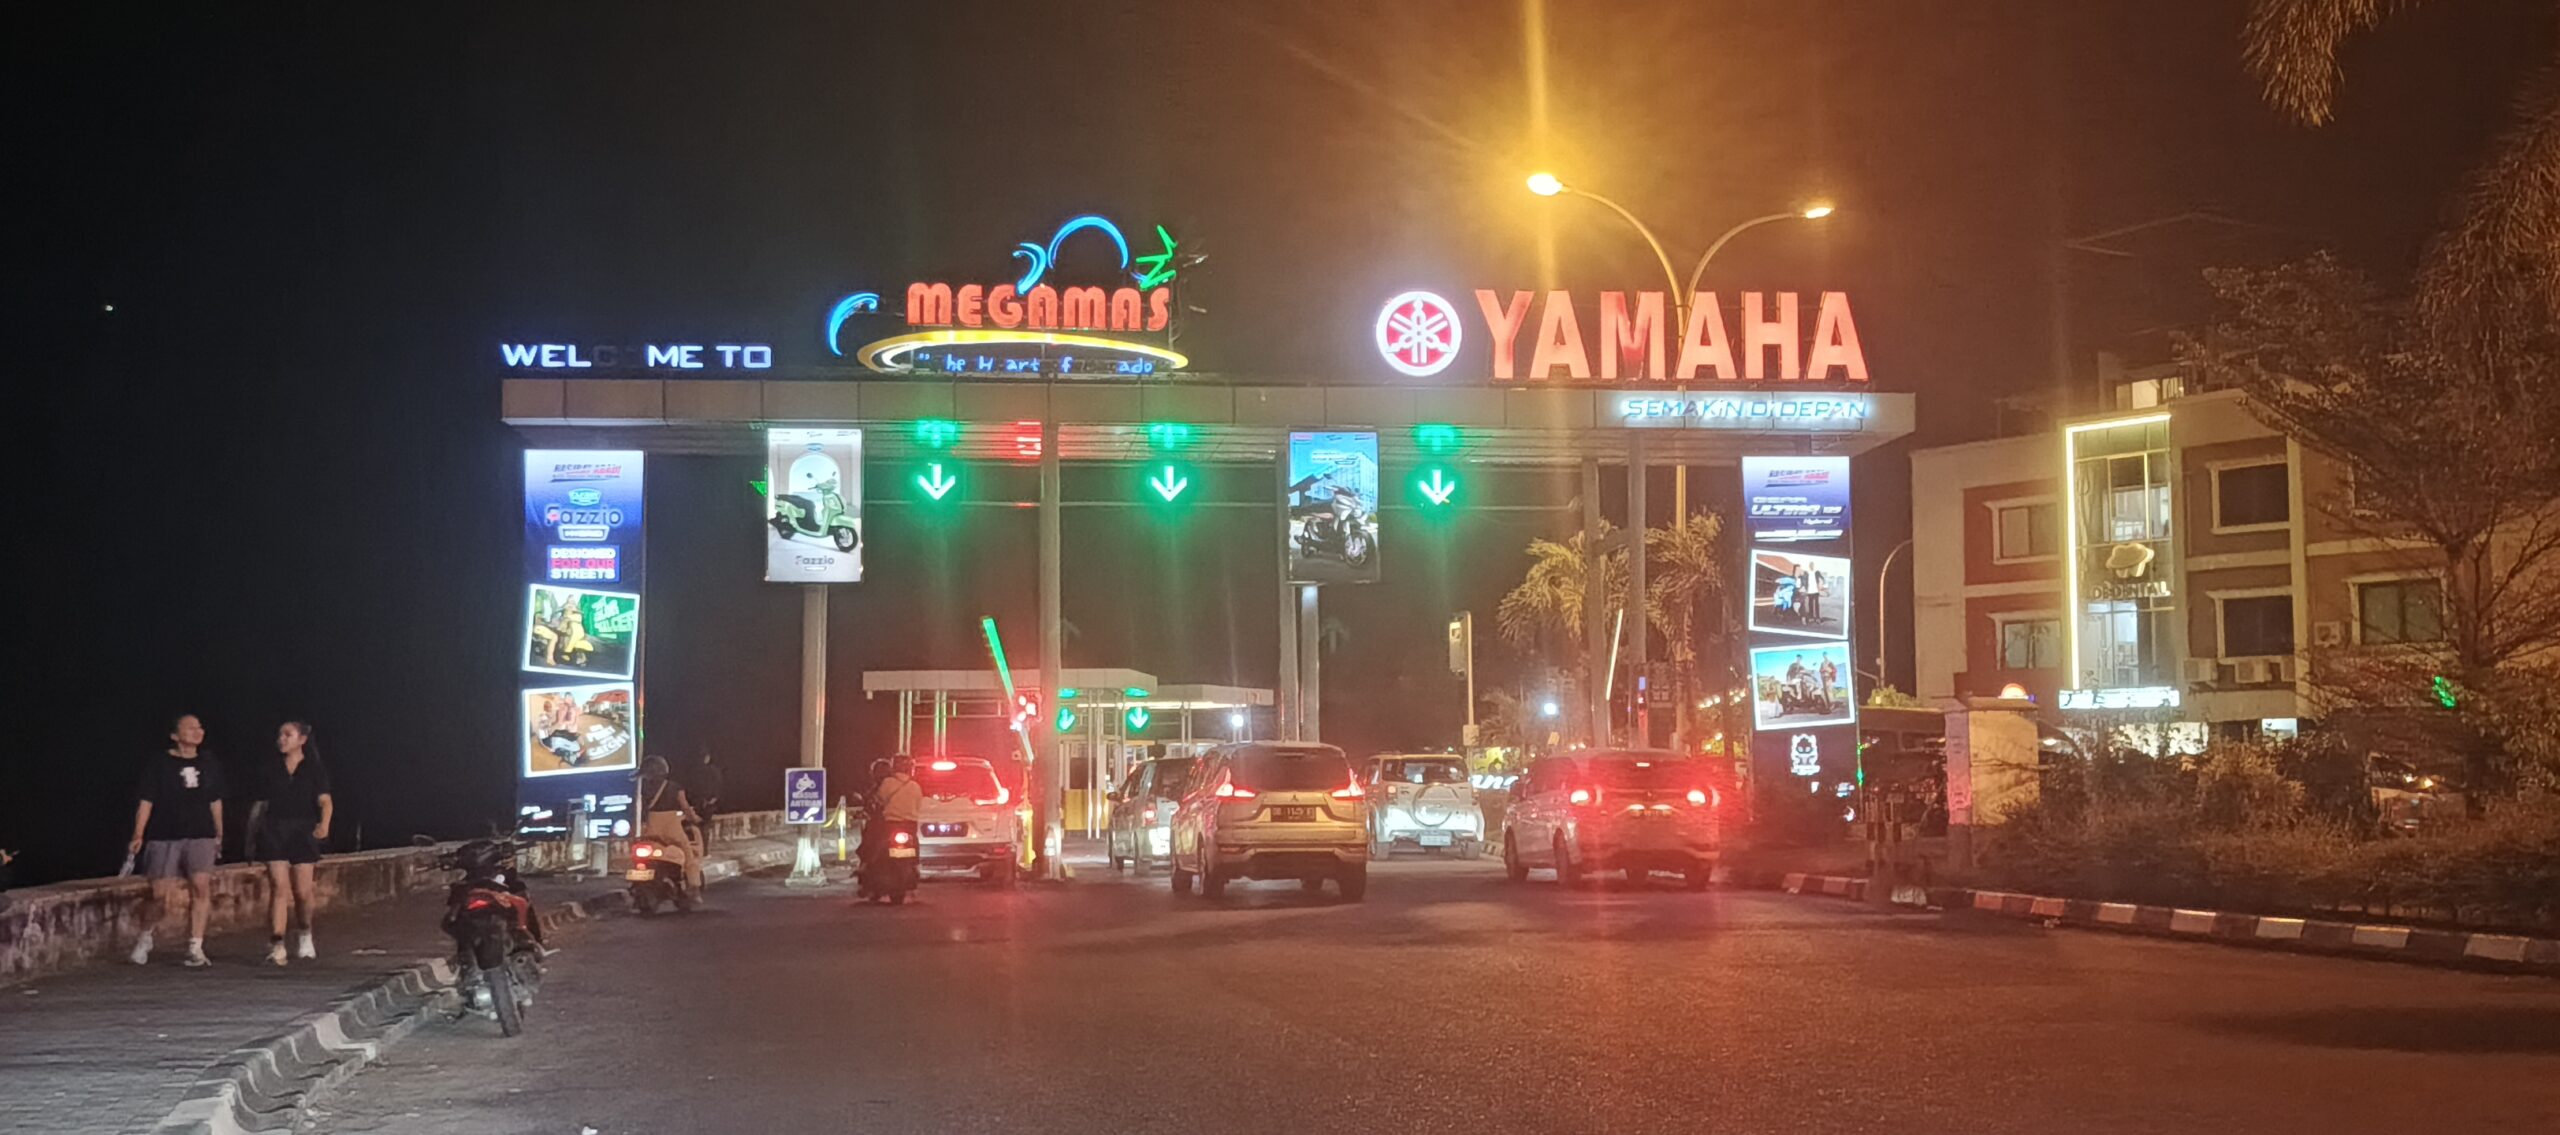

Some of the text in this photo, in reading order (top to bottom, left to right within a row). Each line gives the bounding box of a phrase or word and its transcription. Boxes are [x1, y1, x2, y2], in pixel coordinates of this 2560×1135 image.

[907, 282, 1170, 331] MEGAMAS
[1474, 289, 1869, 380] YAMAHA
[716, 345, 772, 368] TO
[1627, 400, 1745, 417] SEMAKIN
[1780, 400, 1868, 417] DEPAN
[545, 505, 622, 525] Fazzio
[550, 569, 616, 579] STREETS
[551, 559, 615, 569] FOR OUR
